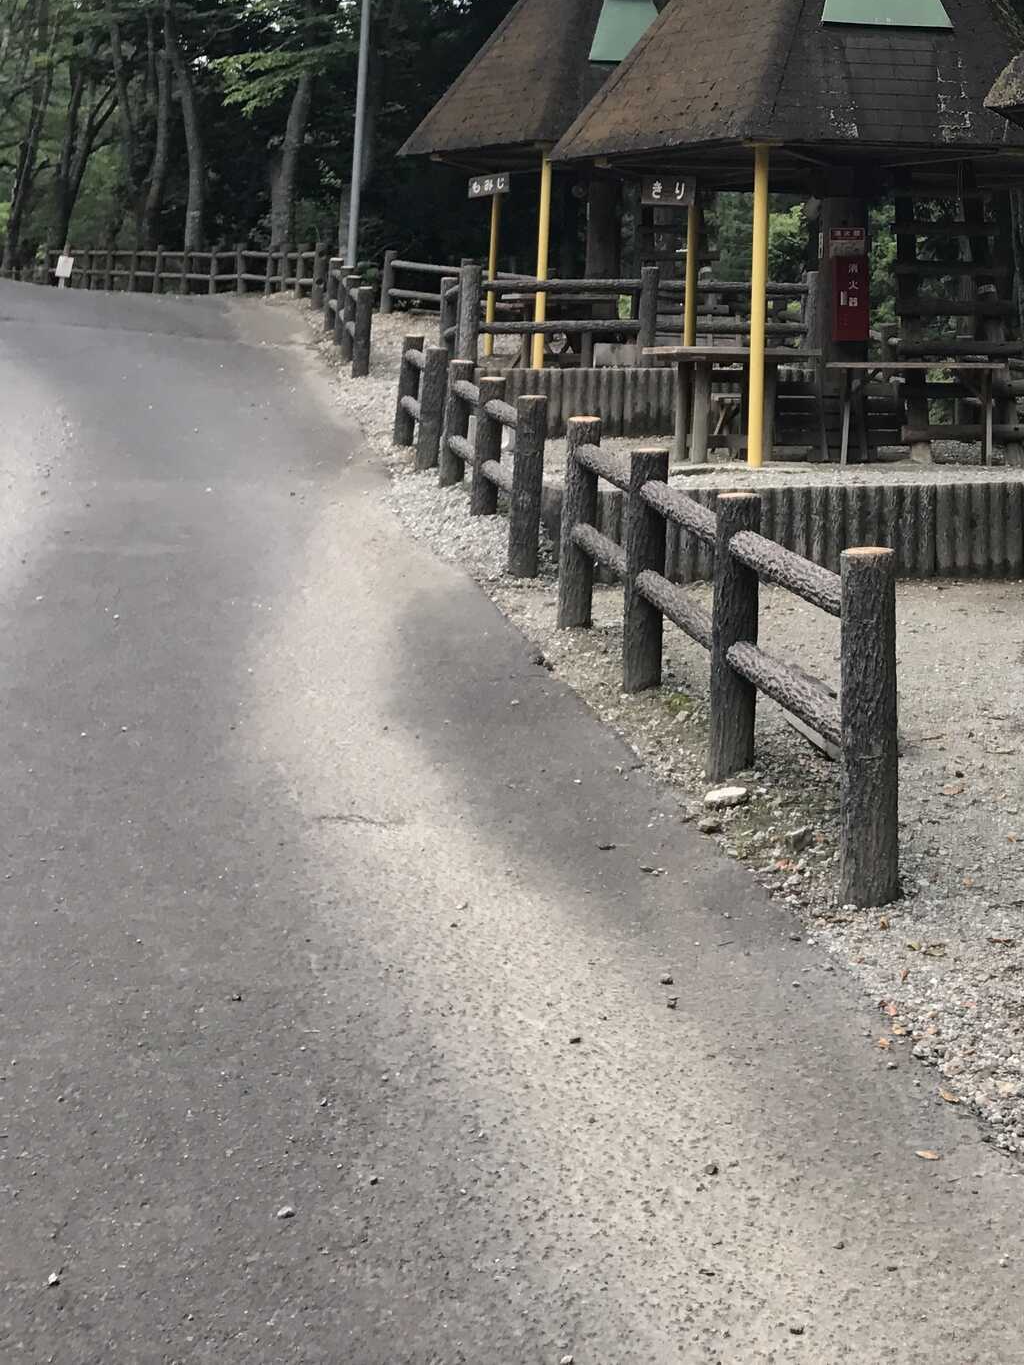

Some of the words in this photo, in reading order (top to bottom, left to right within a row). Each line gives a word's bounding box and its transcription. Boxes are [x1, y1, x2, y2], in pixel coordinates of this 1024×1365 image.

[472, 177, 505, 194] もみじ
[652, 181, 685, 200] きり
